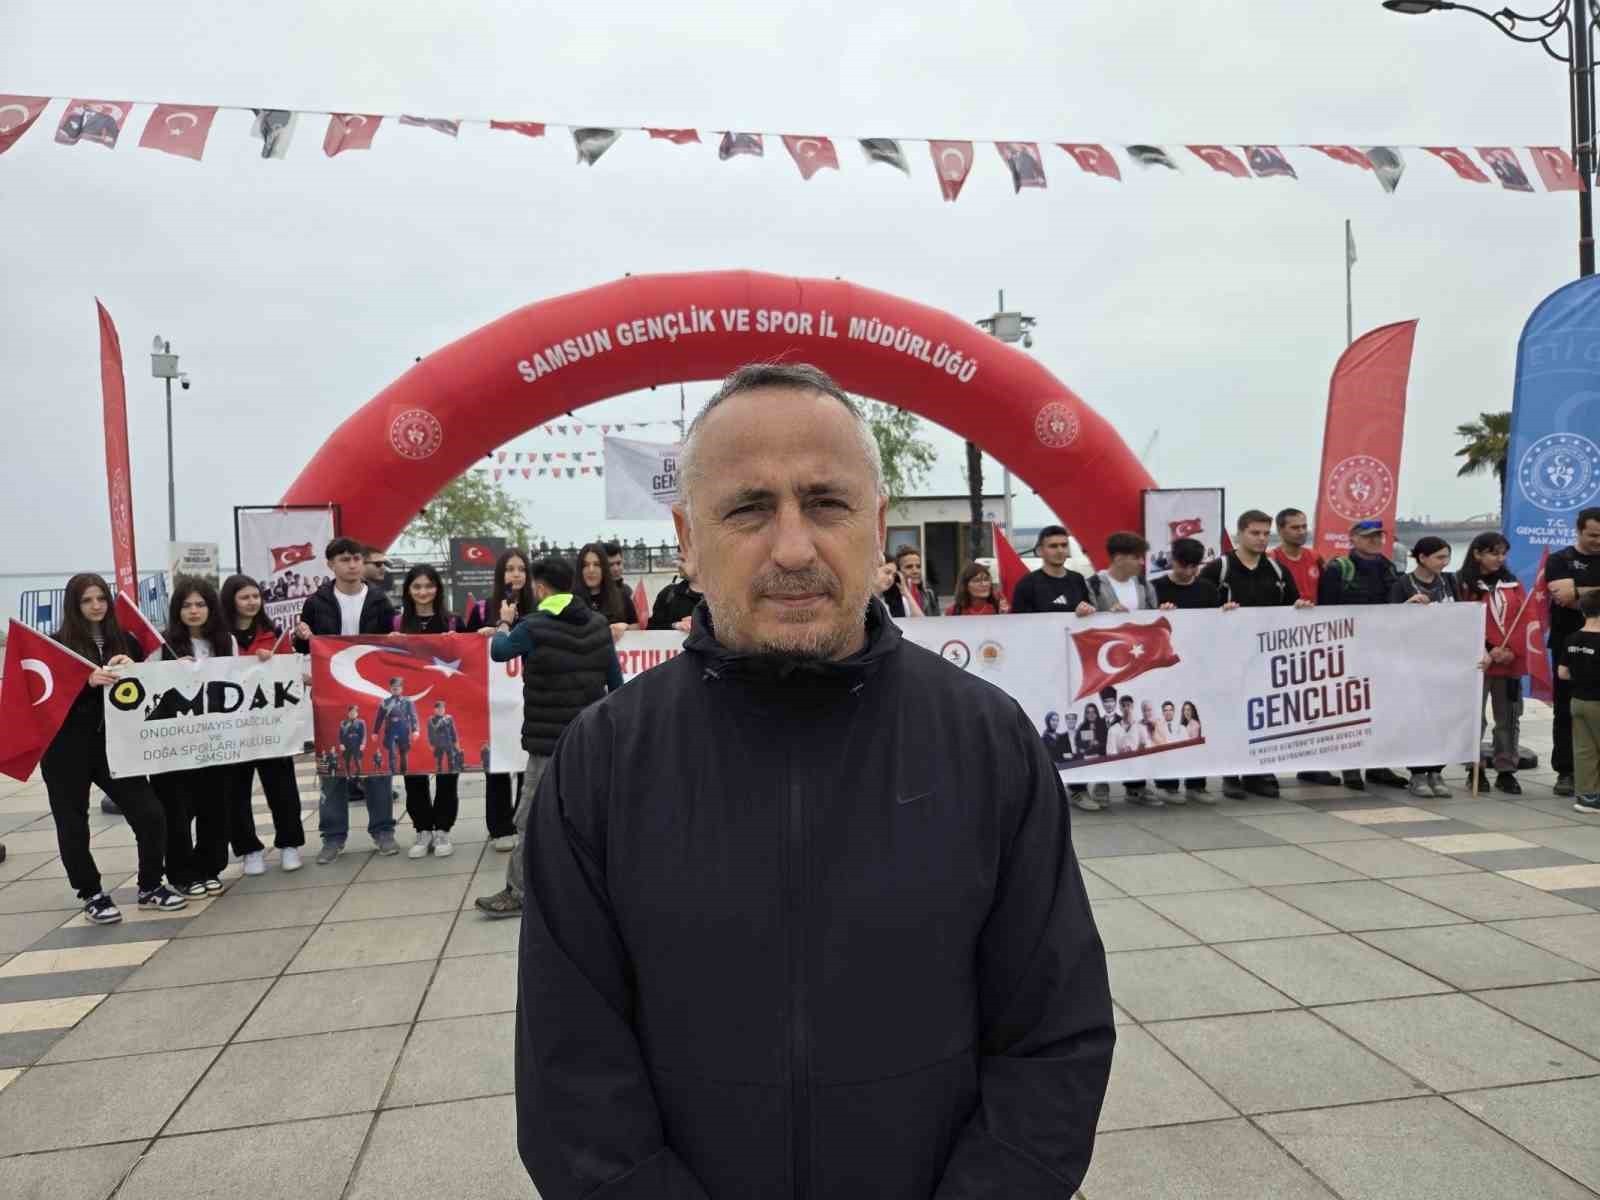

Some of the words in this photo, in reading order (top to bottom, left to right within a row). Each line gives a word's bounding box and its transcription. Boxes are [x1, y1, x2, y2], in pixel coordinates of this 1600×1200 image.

[517, 328, 612, 383] SAMSUN
[616, 305, 715, 343] GENÇLİK
[720, 309, 750, 332] VE
[755, 309, 813, 335] SPOR
[819, 309, 838, 338] İL
[848, 316, 978, 383] MÜDÜRLÜĞÜ
[1271, 644, 1345, 688] GÜCÜ
[1247, 676, 1371, 731] GENÇLİĞİ
[181, 740, 237, 757] SPOLARI
